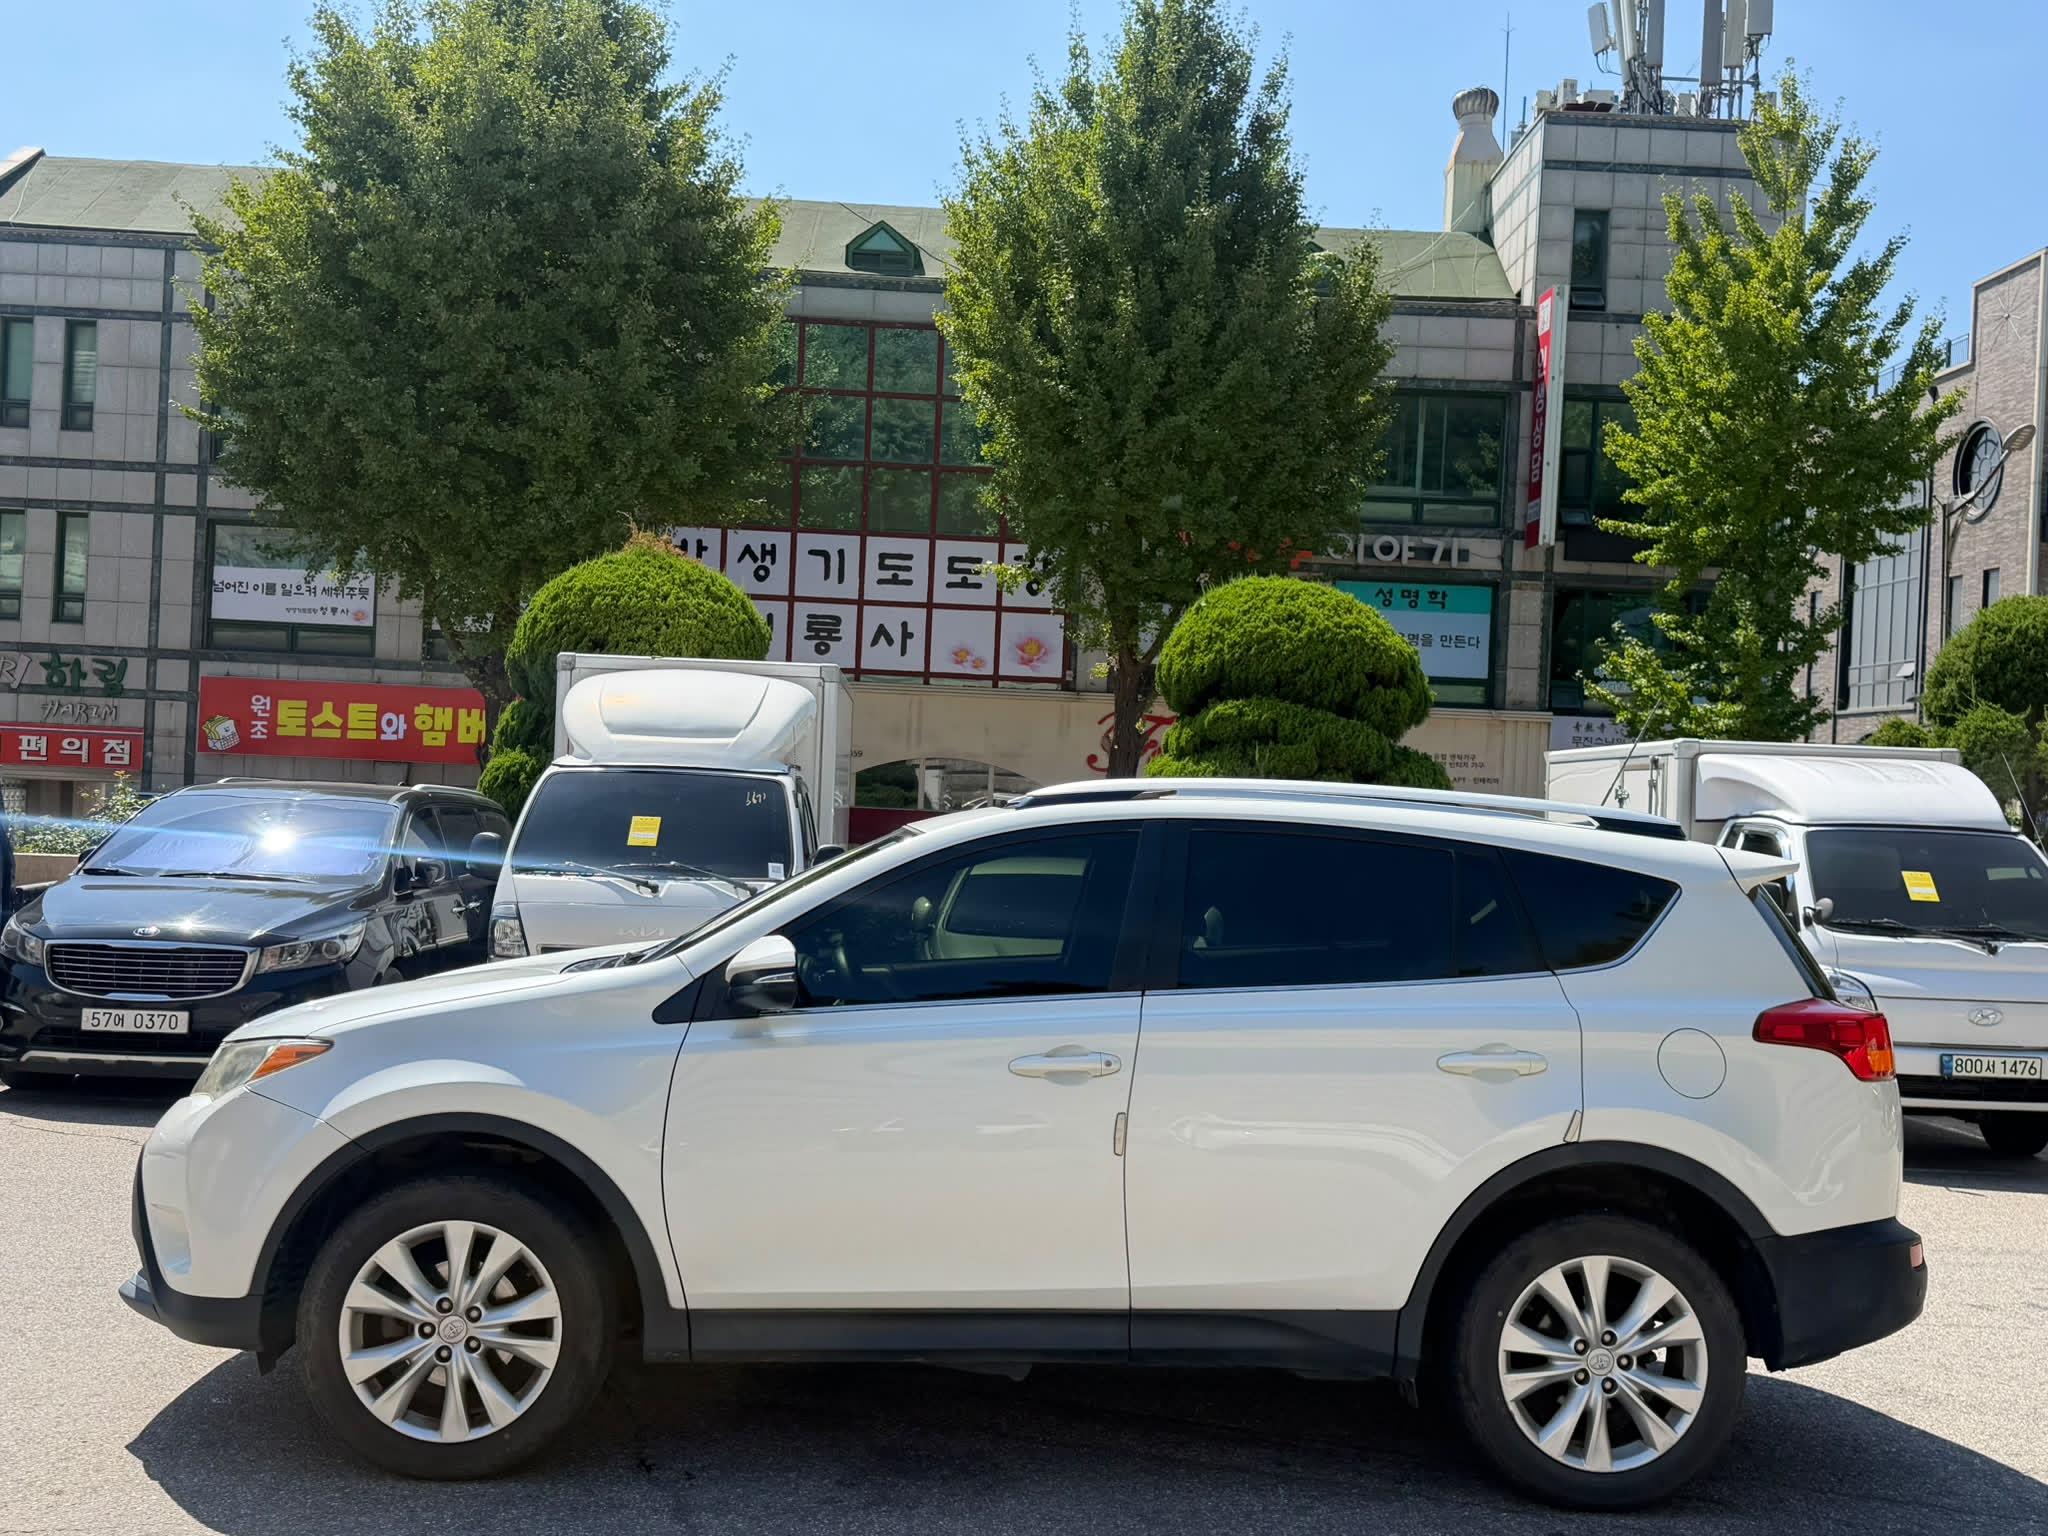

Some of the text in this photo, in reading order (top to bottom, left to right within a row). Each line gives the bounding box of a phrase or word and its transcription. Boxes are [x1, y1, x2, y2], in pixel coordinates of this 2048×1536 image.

[675, 538, 1049, 597] 생기도도
[253, 581, 277, 596] 이를
[281, 582, 317, 598] 일으켜
[1374, 587, 1448, 610] 성명학
[1439, 633, 1481, 650] 만든다
[40, 649, 129, 698] 하림
[250, 694, 271, 739] 원조
[276, 699, 407, 742] 토스트와
[18, 735, 132, 765] 편의점
[90, 1011, 179, 1030] 57어 0370
[1954, 1057, 2038, 1076] 800서 1476
